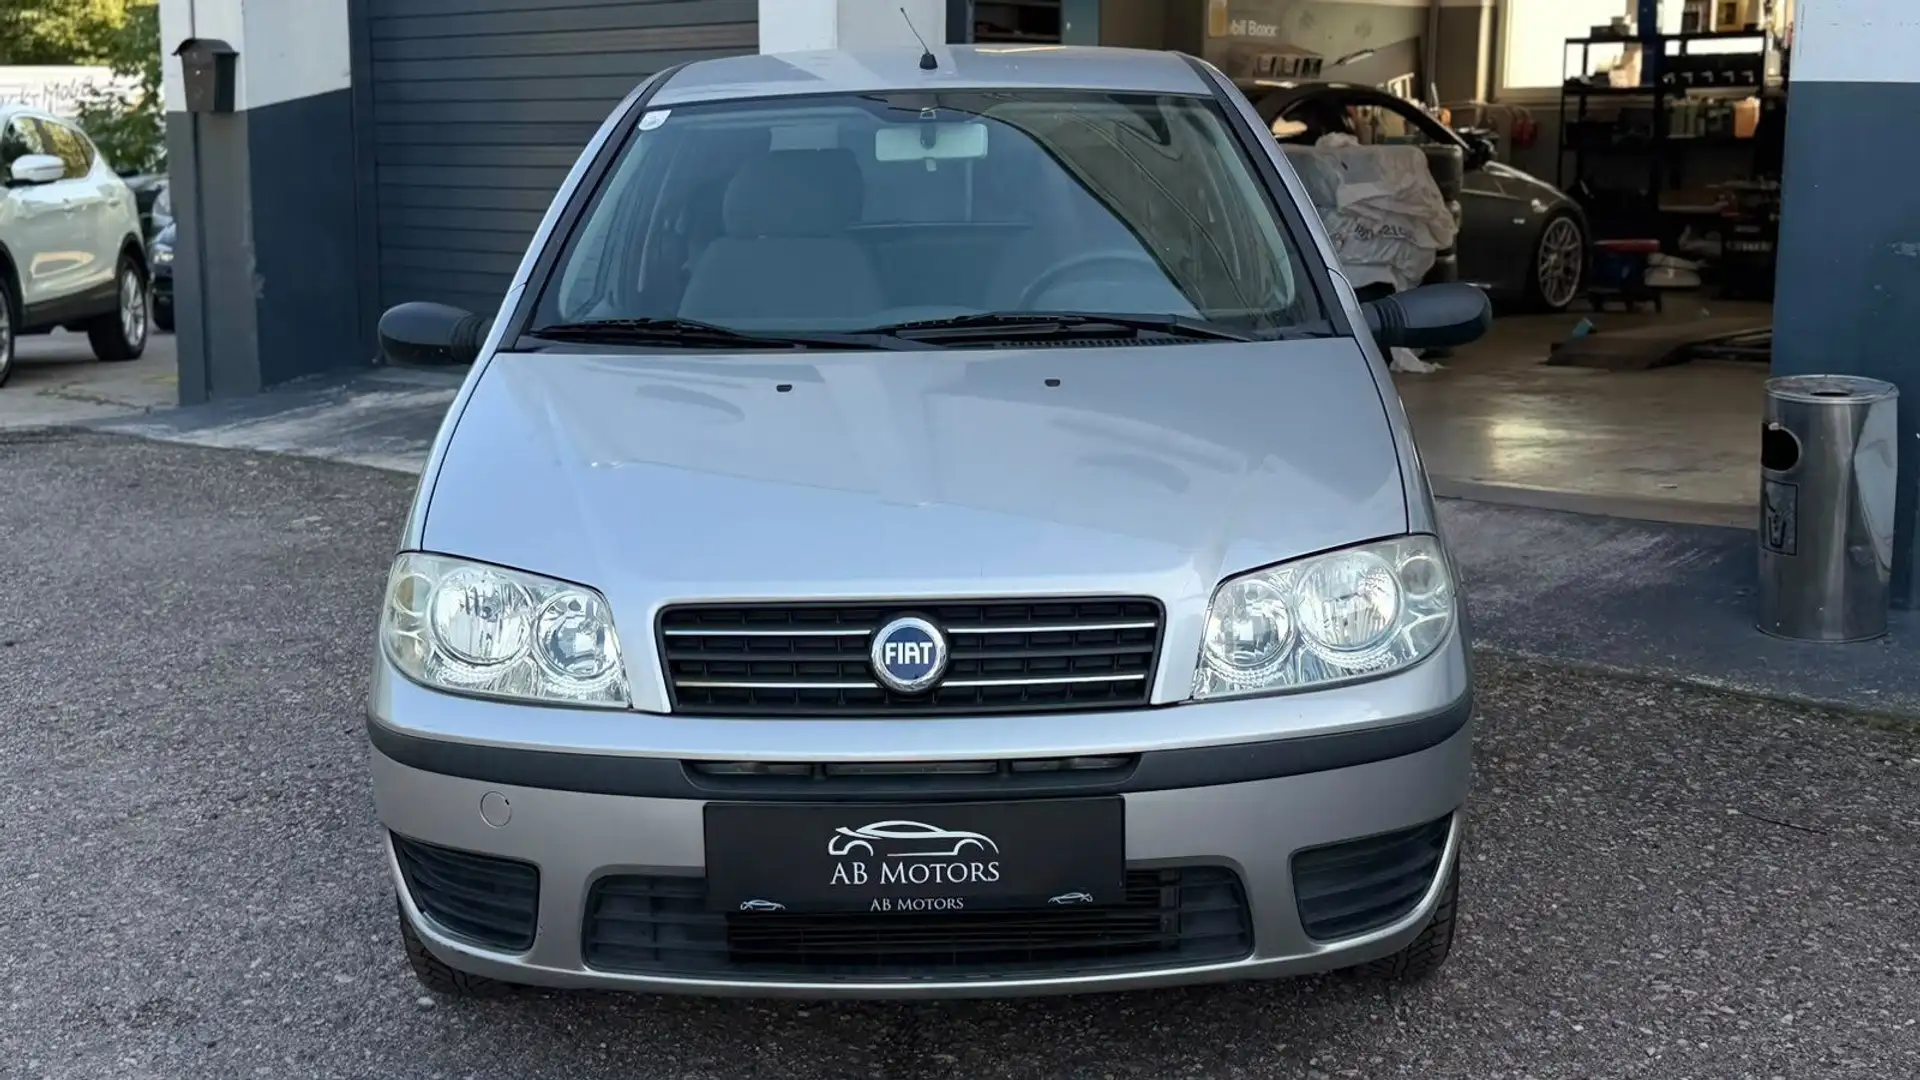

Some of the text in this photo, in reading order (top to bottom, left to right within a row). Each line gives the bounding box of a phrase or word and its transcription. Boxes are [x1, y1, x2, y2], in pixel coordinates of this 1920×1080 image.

[1230, 19, 1246, 36] bil
[885, 642, 933, 665] FIAT
[830, 861, 1000, 885] AB MOTORS
[870, 898, 964, 912] AB MOTORS
